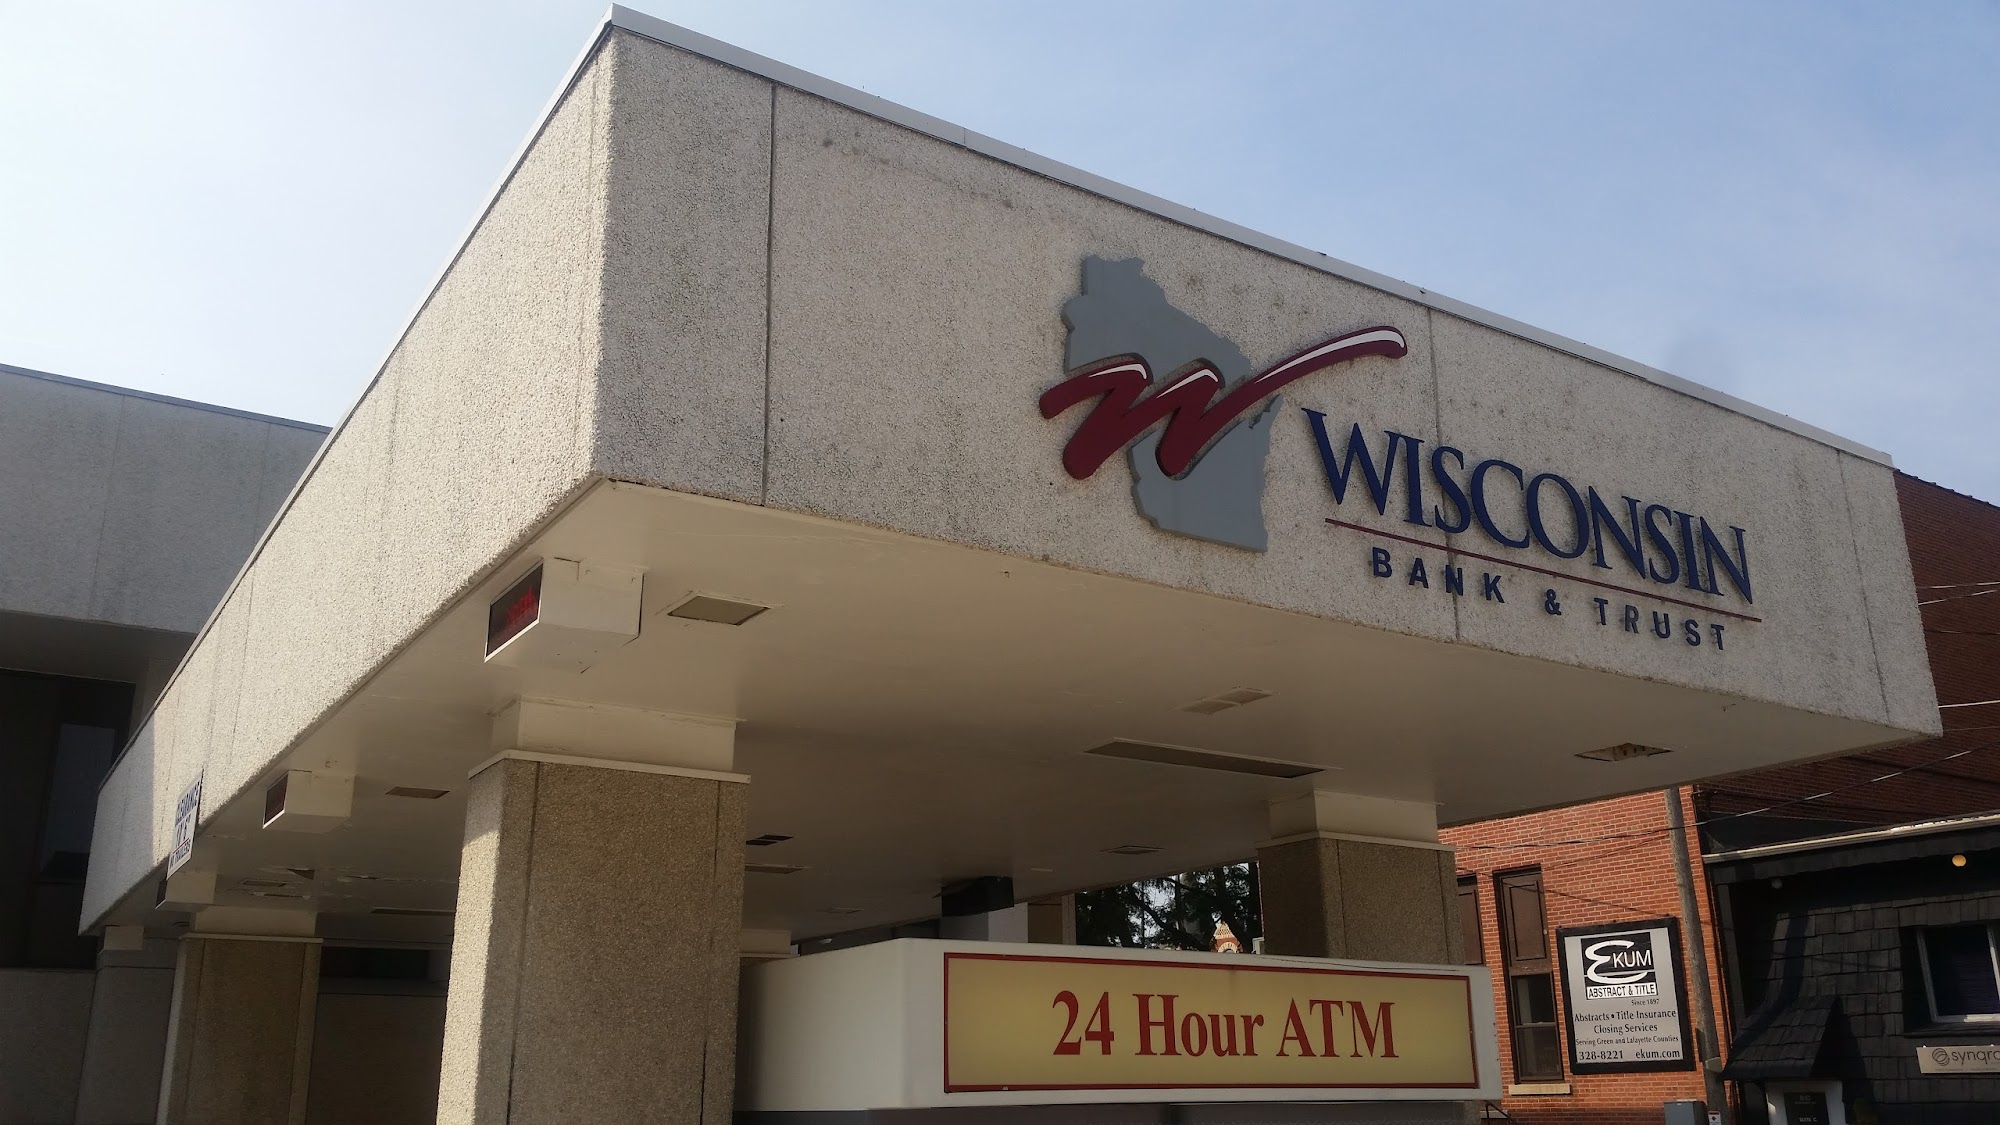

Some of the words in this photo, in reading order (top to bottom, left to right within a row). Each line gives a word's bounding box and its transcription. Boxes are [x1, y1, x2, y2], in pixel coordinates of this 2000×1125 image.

[1301, 407, 1753, 604] WISCONSIN
[1372, 546, 1505, 604] BANK
[1544, 588, 1562, 616] &
[1594, 597, 1725, 651] TRUST
[1585, 940, 1652, 984] EKUM
[1588, 986, 1626, 998] ABSTRACT
[1628, 985, 1633, 996] &
[1635, 984, 1655, 995] TITLE
[1574, 1012, 1610, 1022] Abstracts
[1616, 1011, 1634, 1020] Title
[1636, 1010, 1677, 1019] Insurance
[1052, 990, 1115, 1055] 24
[1132, 993, 1264, 1057] Hour
[1276, 997, 1400, 1058] ATM
[1593, 1023, 1624, 1036] Closing
[1624, 1023, 1658, 1033] Services
[1575, 1039, 1596, 1047] Serving
[1596, 1037, 1614, 1045] Green
[1626, 1036, 1652, 1046] Lafayette
[1652, 1034, 1679, 1043] Counties
[1579, 1050, 1624, 1060] 328-8221
[1635, 1049, 1680, 1059] ekum.com
